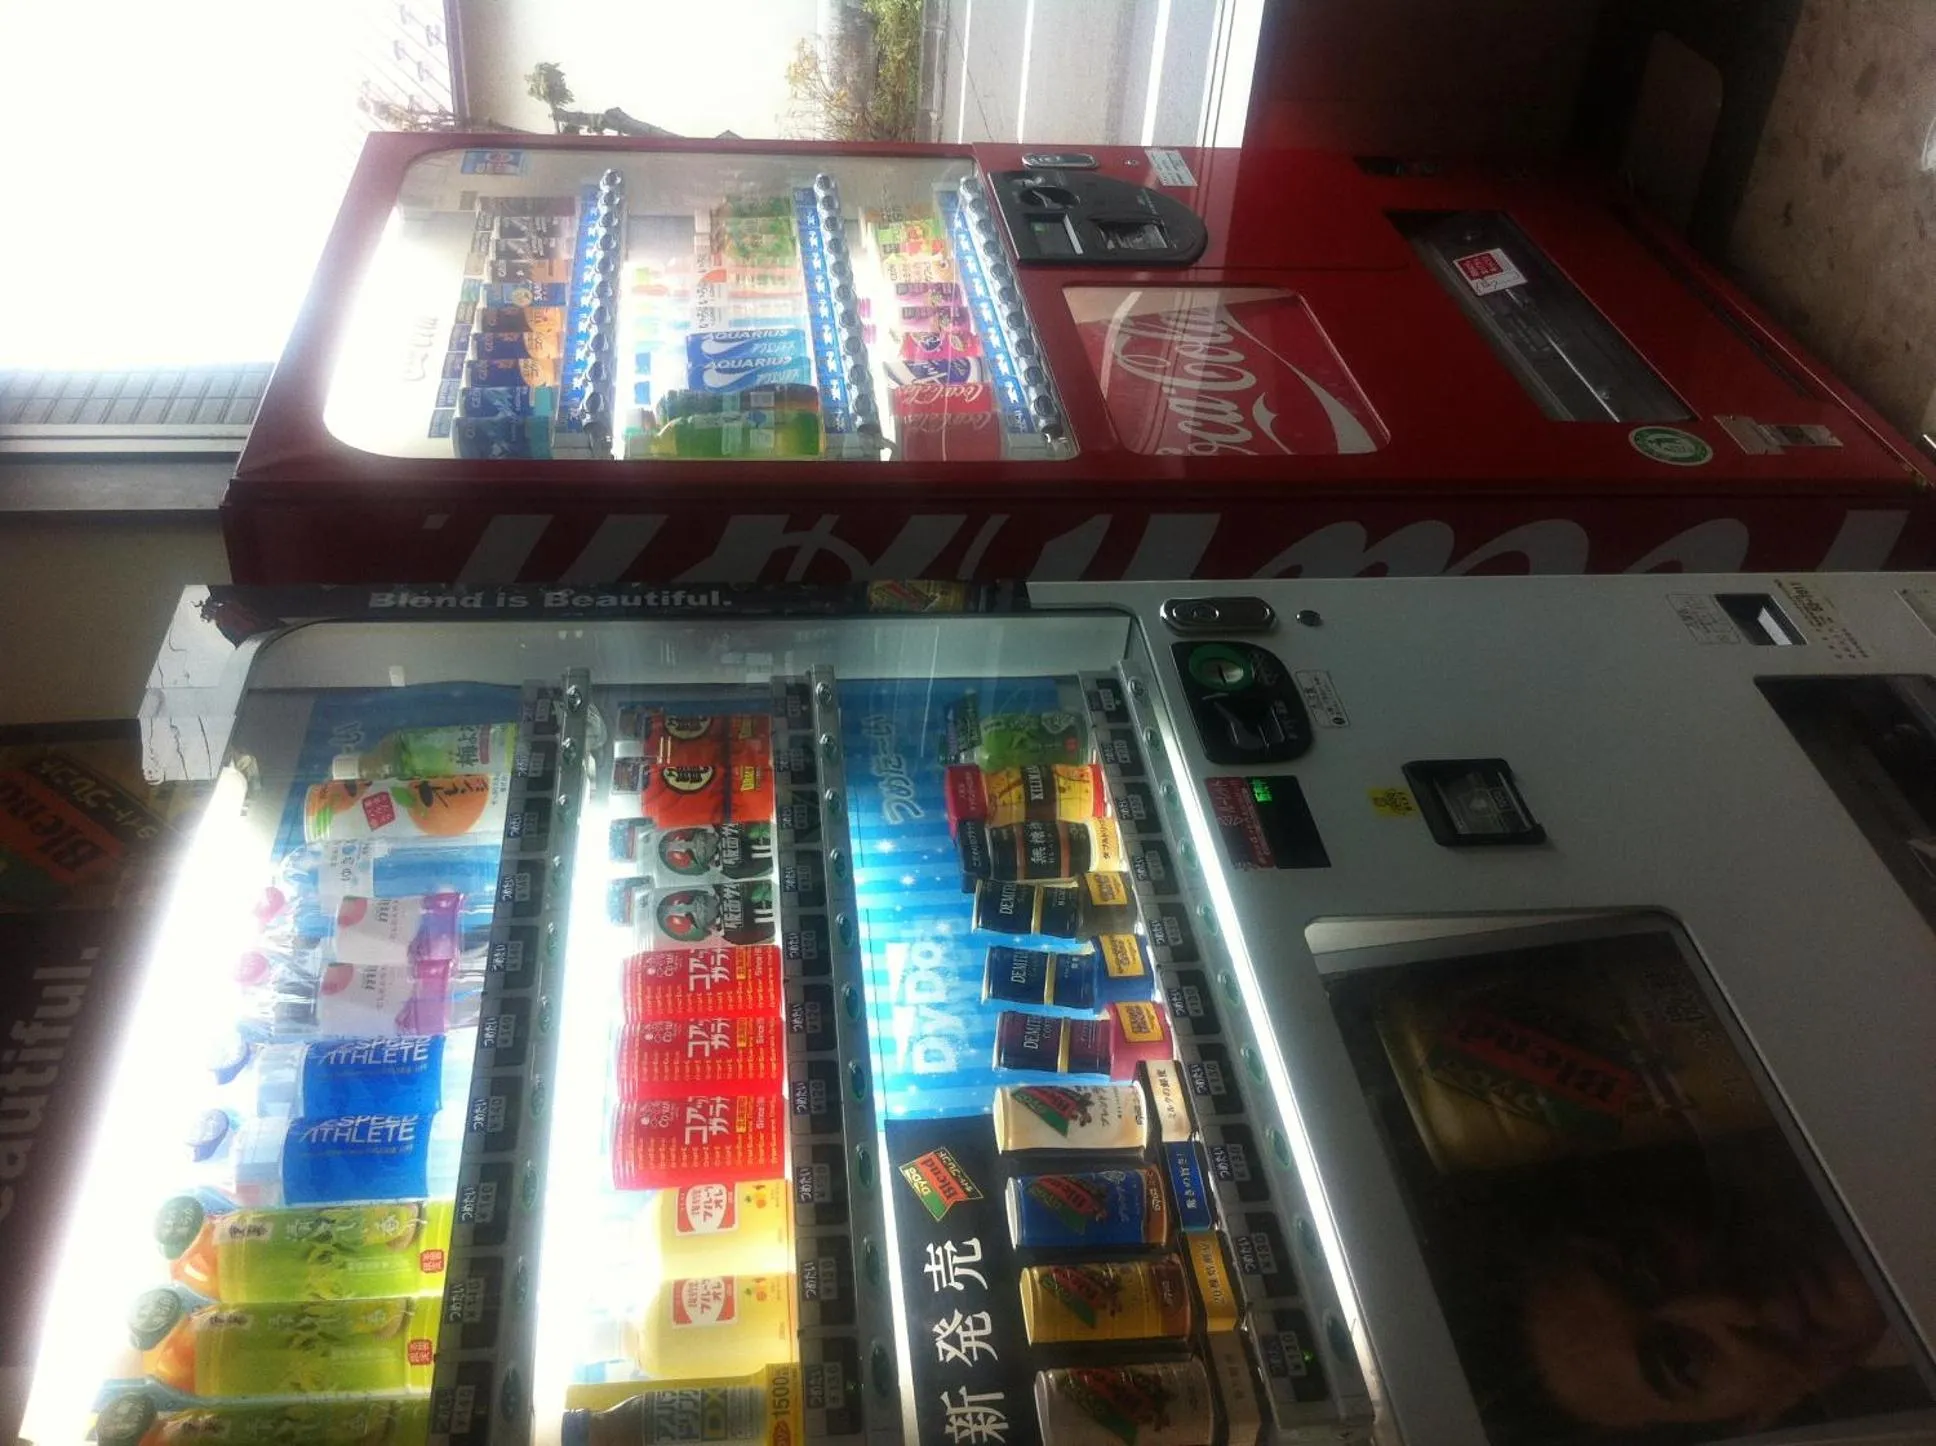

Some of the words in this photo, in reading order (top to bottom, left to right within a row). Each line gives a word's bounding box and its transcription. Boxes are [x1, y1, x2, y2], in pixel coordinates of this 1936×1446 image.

[369, 590, 483, 609] Blend
[495, 590, 529, 608] is
[542, 589, 733, 609] Beautiful.
[793, 1004, 803, 1032] つめたい
[1190, 1064, 1207, 1094] つめたい
[796, 1083, 807, 1113] つめたい
[1211, 1147, 1229, 1178] つめたい
[801, 1169, 812, 1201] つめたい
[904, 1166, 932, 1196] DyDo
[922, 1157, 957, 1200] Blend
[1238, 1236, 1257, 1272] つめたい
[805, 1262, 817, 1298] つめたい
[923, 1237, 1009, 1444] 新発売
